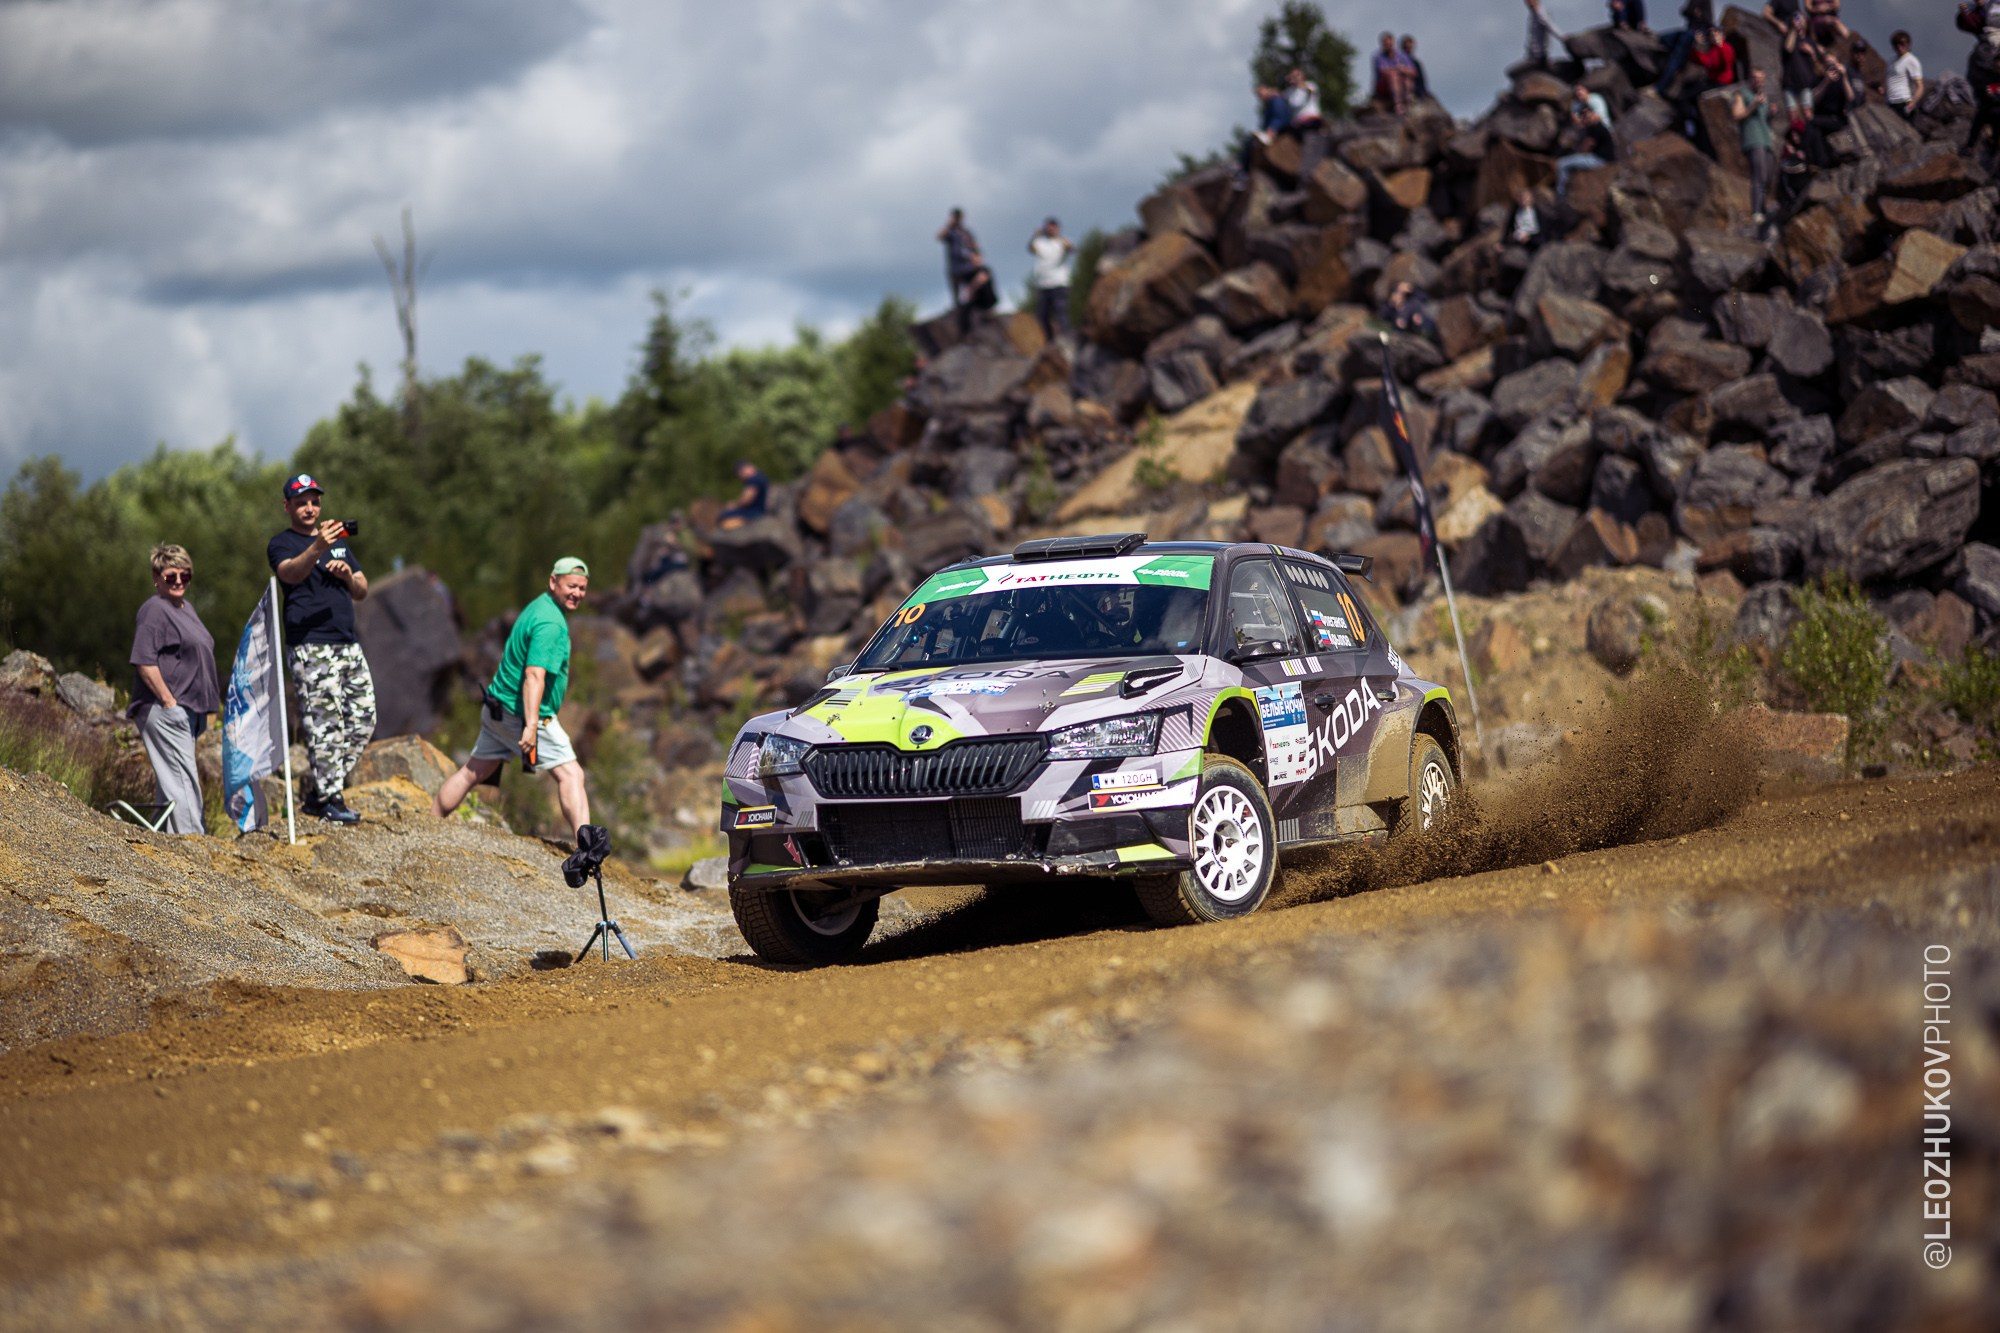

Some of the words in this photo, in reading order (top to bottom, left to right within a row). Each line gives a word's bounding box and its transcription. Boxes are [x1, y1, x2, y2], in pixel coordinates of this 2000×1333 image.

[1013, 572, 1120, 585] ТАТНЕФТЬ
[893, 603, 926, 628] 10
[1337, 592, 1365, 641] 10
[1260, 700, 1286, 719] БЕЛЫЕ
[1285, 698, 1306, 715] НОЧИ
[748, 811, 773, 822] YOKOHAMA
